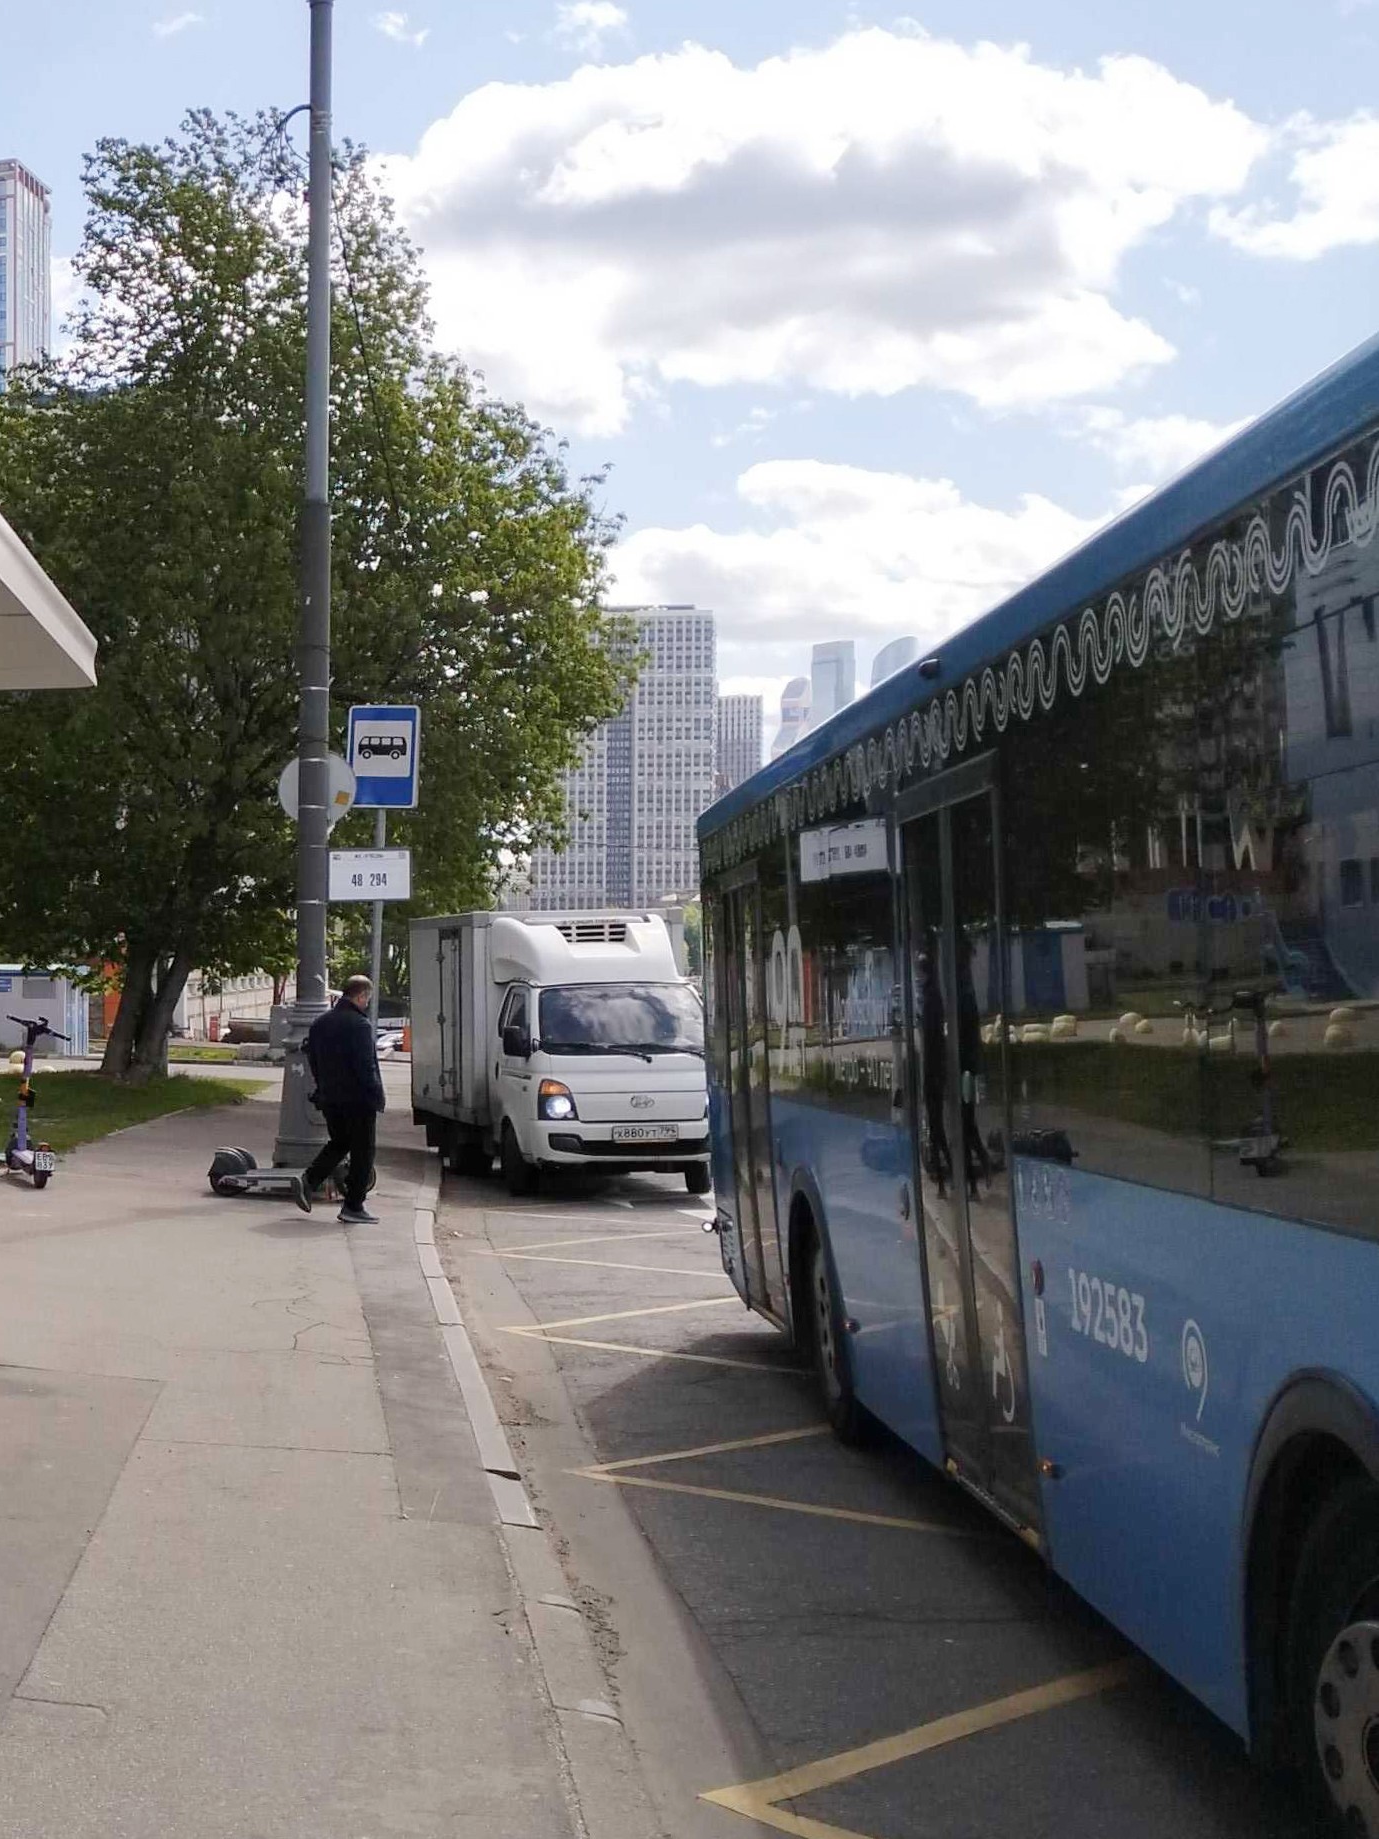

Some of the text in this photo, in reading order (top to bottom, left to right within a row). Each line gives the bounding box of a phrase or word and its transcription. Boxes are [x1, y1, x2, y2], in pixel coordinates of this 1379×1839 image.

[351, 872, 387, 887] 48 294
[1067, 1266, 1149, 1363] 192583
